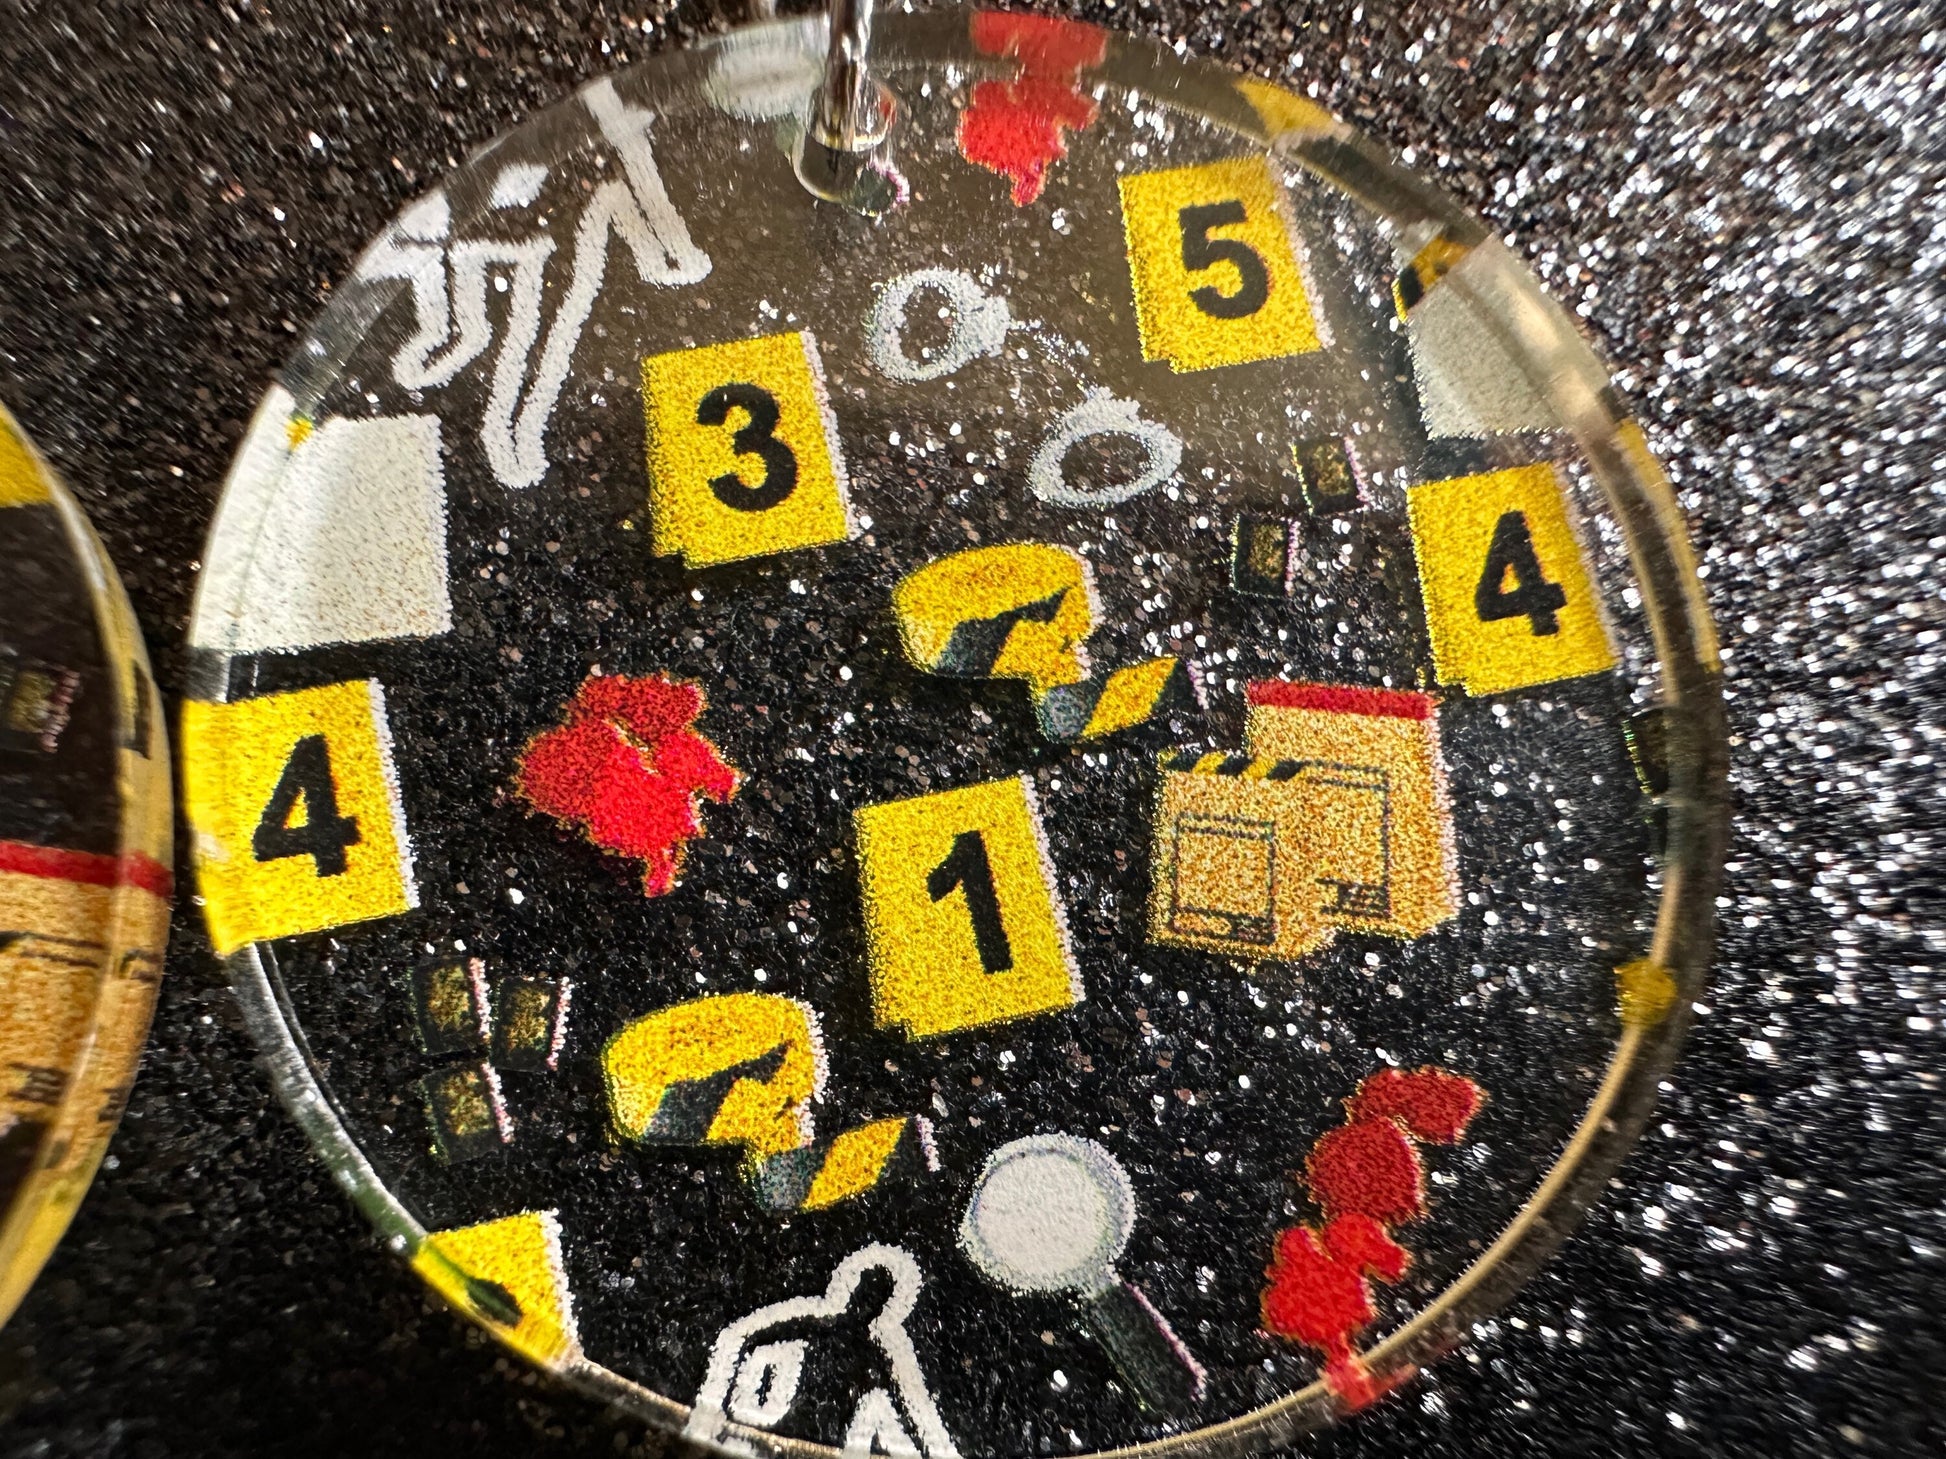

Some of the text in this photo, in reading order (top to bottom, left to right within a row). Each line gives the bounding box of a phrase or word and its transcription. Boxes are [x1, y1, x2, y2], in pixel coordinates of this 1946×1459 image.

[1182, 202, 1266, 318] 5
[697, 384, 796, 511] 3
[1476, 513, 1565, 635] 4
[253, 735, 360, 877] 4
[928, 832, 1013, 974] 1
